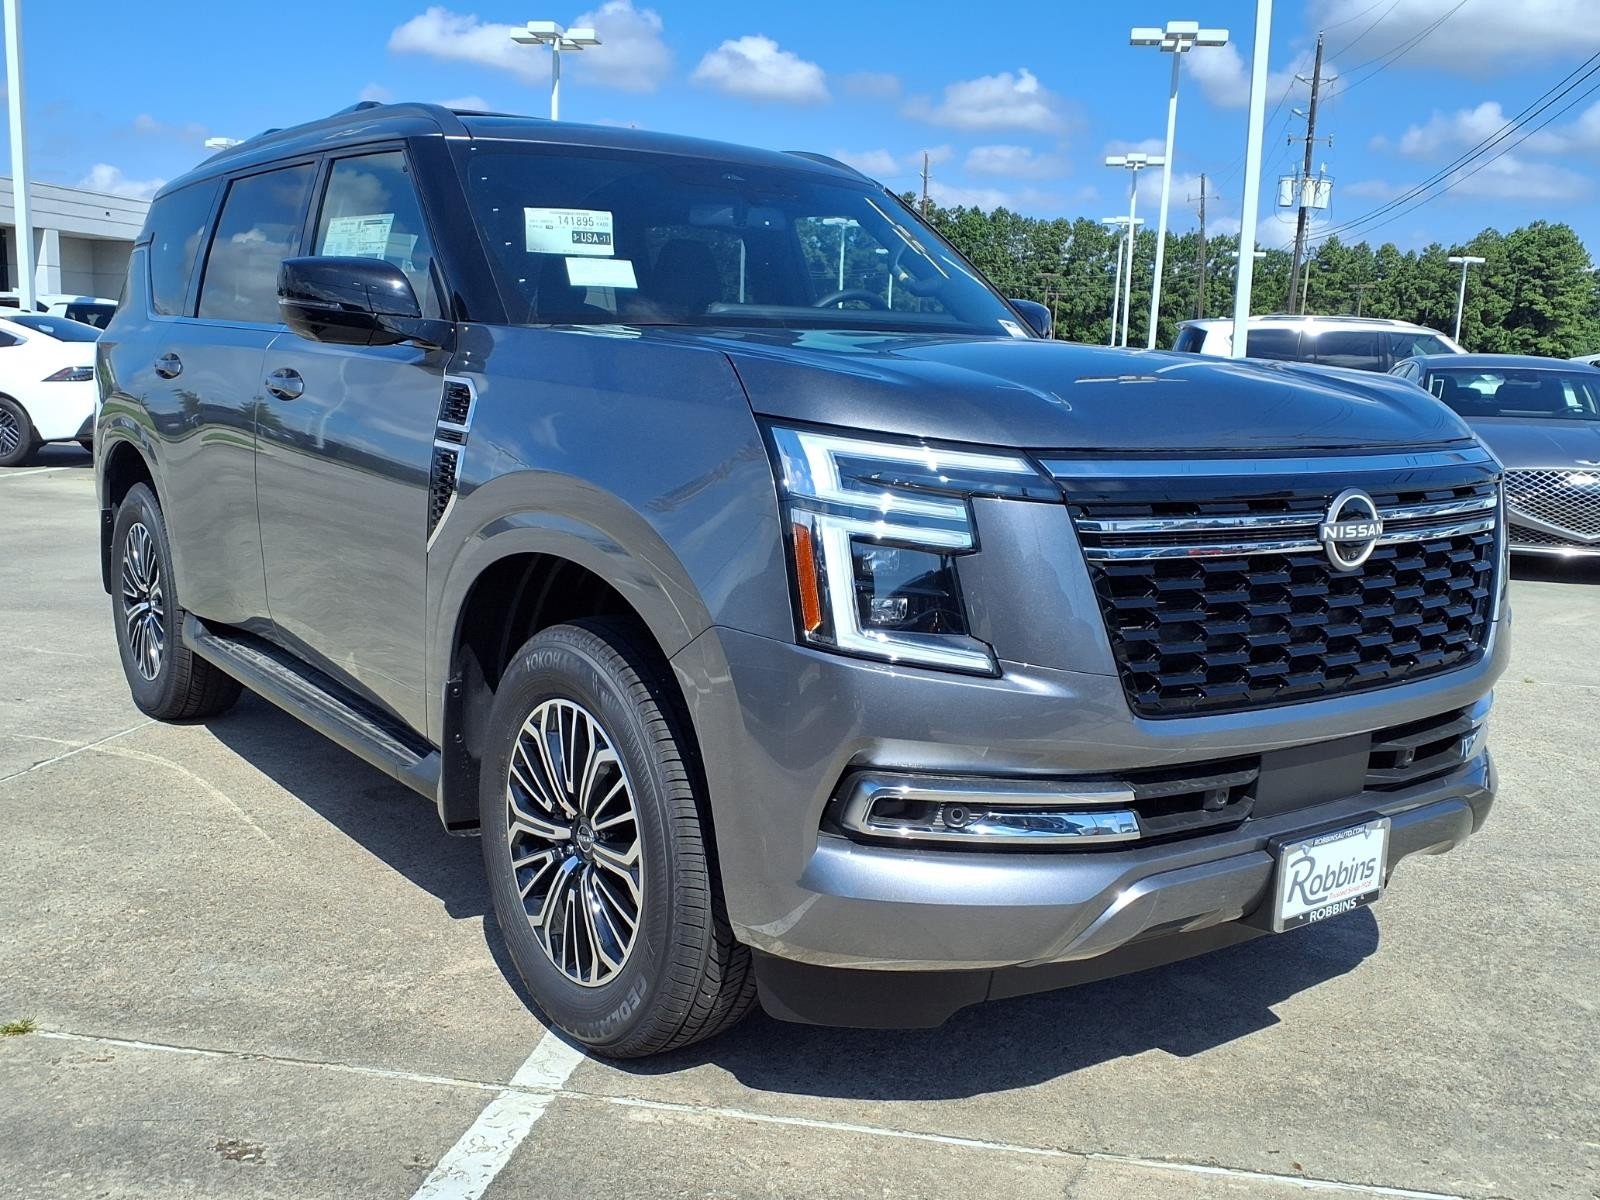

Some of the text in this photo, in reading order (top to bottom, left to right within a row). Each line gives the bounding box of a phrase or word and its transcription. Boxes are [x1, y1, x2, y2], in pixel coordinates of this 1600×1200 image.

[558, 216, 595, 227] 141895
[581, 232, 599, 243] USA
[1323, 523, 1383, 539] NISSAN
[1287, 855, 1377, 906] Robbins
[1310, 897, 1357, 922] ROBBINS
